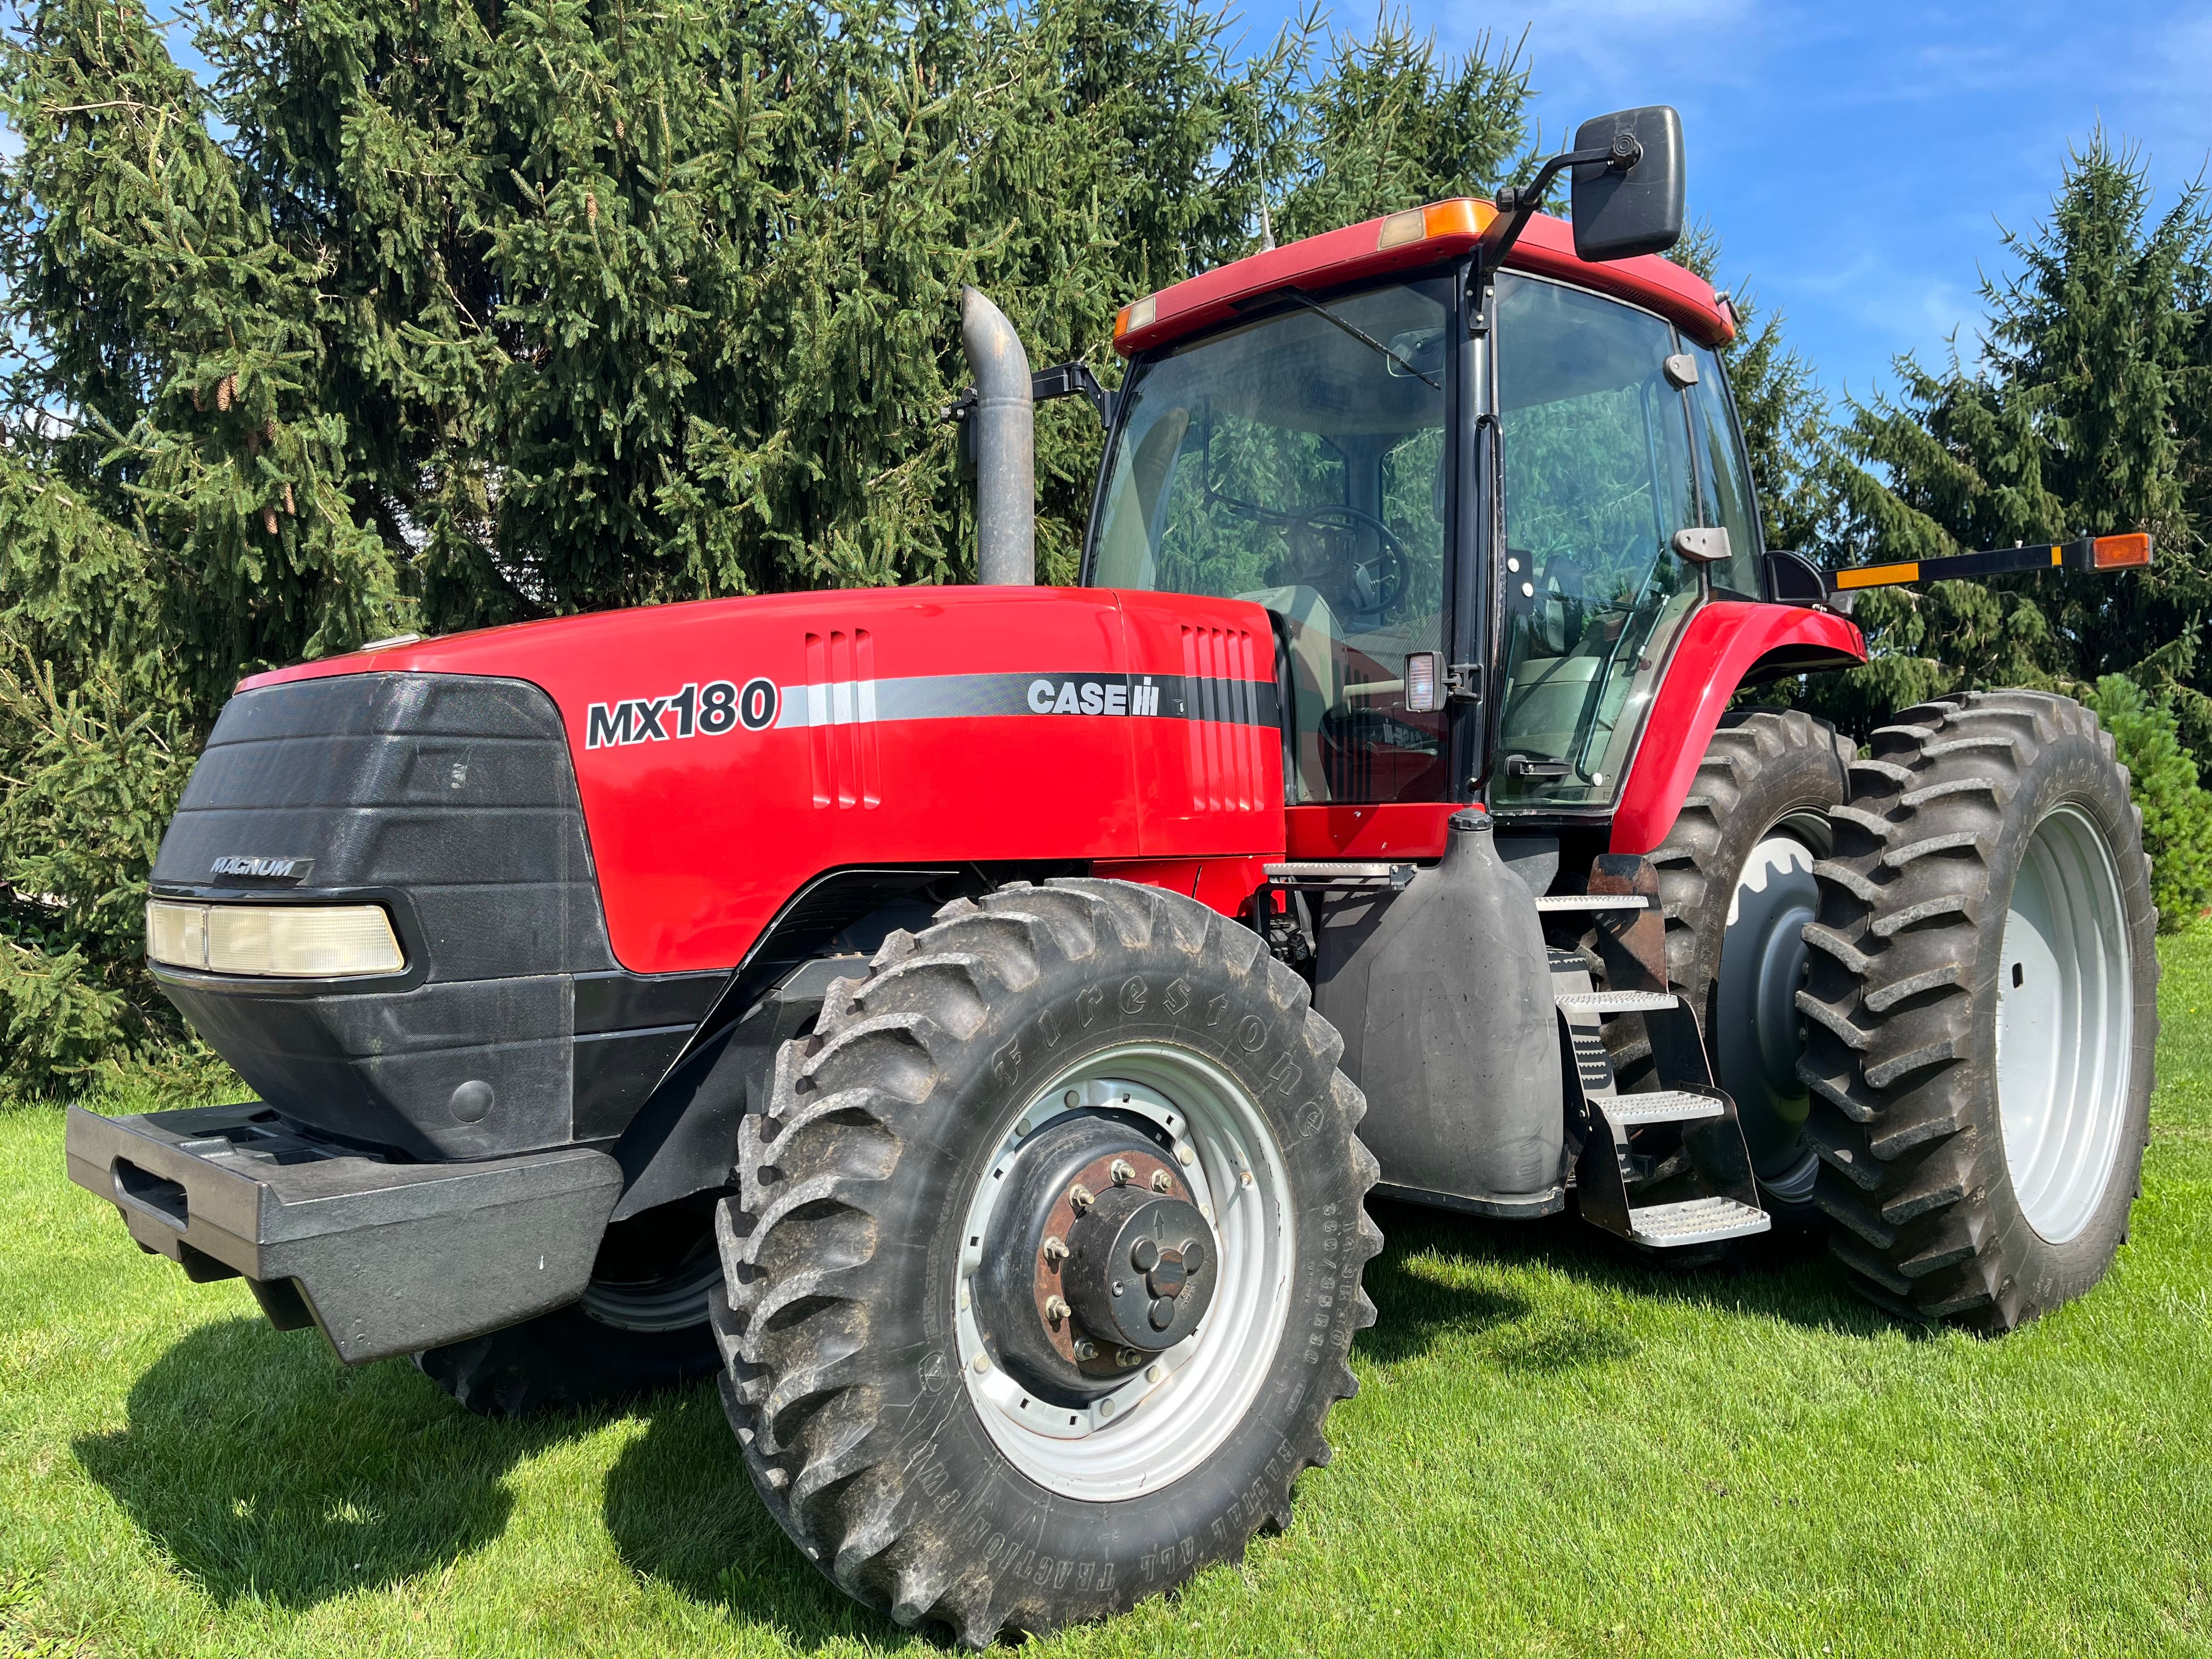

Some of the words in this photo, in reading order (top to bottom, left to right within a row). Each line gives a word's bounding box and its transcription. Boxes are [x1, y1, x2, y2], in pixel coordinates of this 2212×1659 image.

[585, 678, 778, 749] MX180
[210, 856, 295, 877] MAGNUM
[991, 975, 1324, 1138] Firestone
[963, 1516, 1115, 1592] TRACTION
